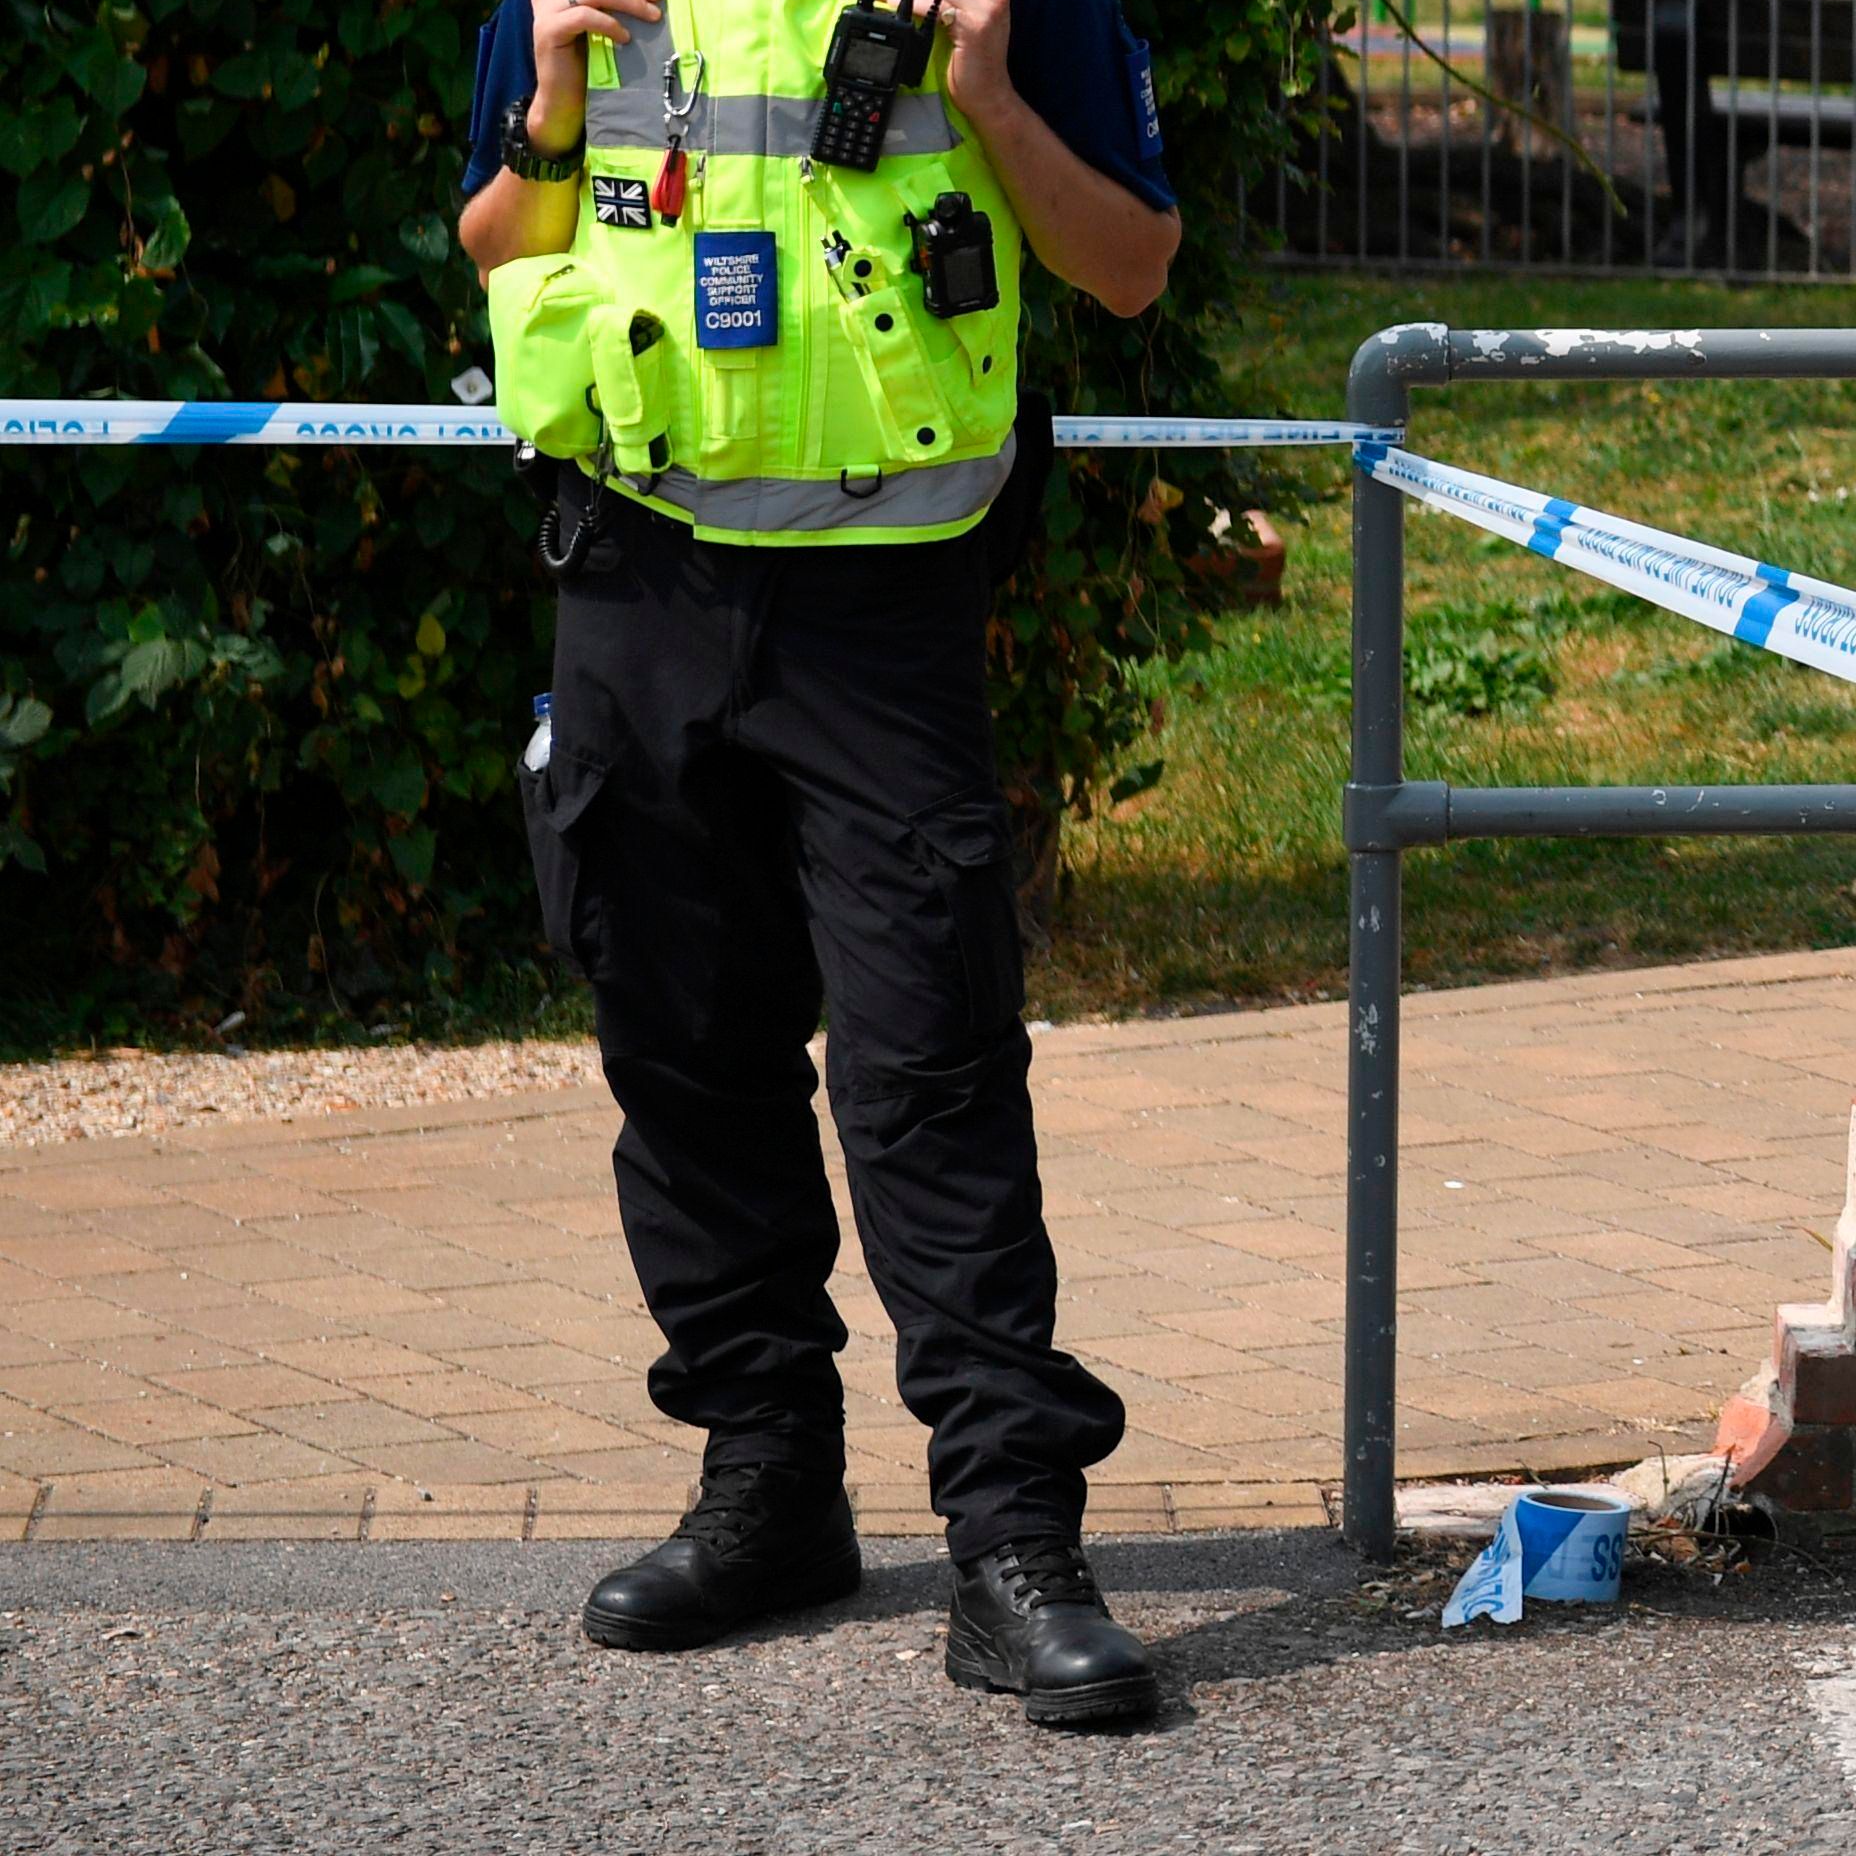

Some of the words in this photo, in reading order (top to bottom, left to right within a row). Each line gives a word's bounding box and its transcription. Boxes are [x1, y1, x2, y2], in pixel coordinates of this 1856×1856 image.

[703, 254, 760, 266] WILTSHIRE
[711, 265, 752, 276] POLICE
[700, 274, 763, 287] COMMUNITY
[707, 284, 759, 296] SUPPORT
[709, 295, 756, 306] OFFICER
[706, 310, 762, 330] C9001
